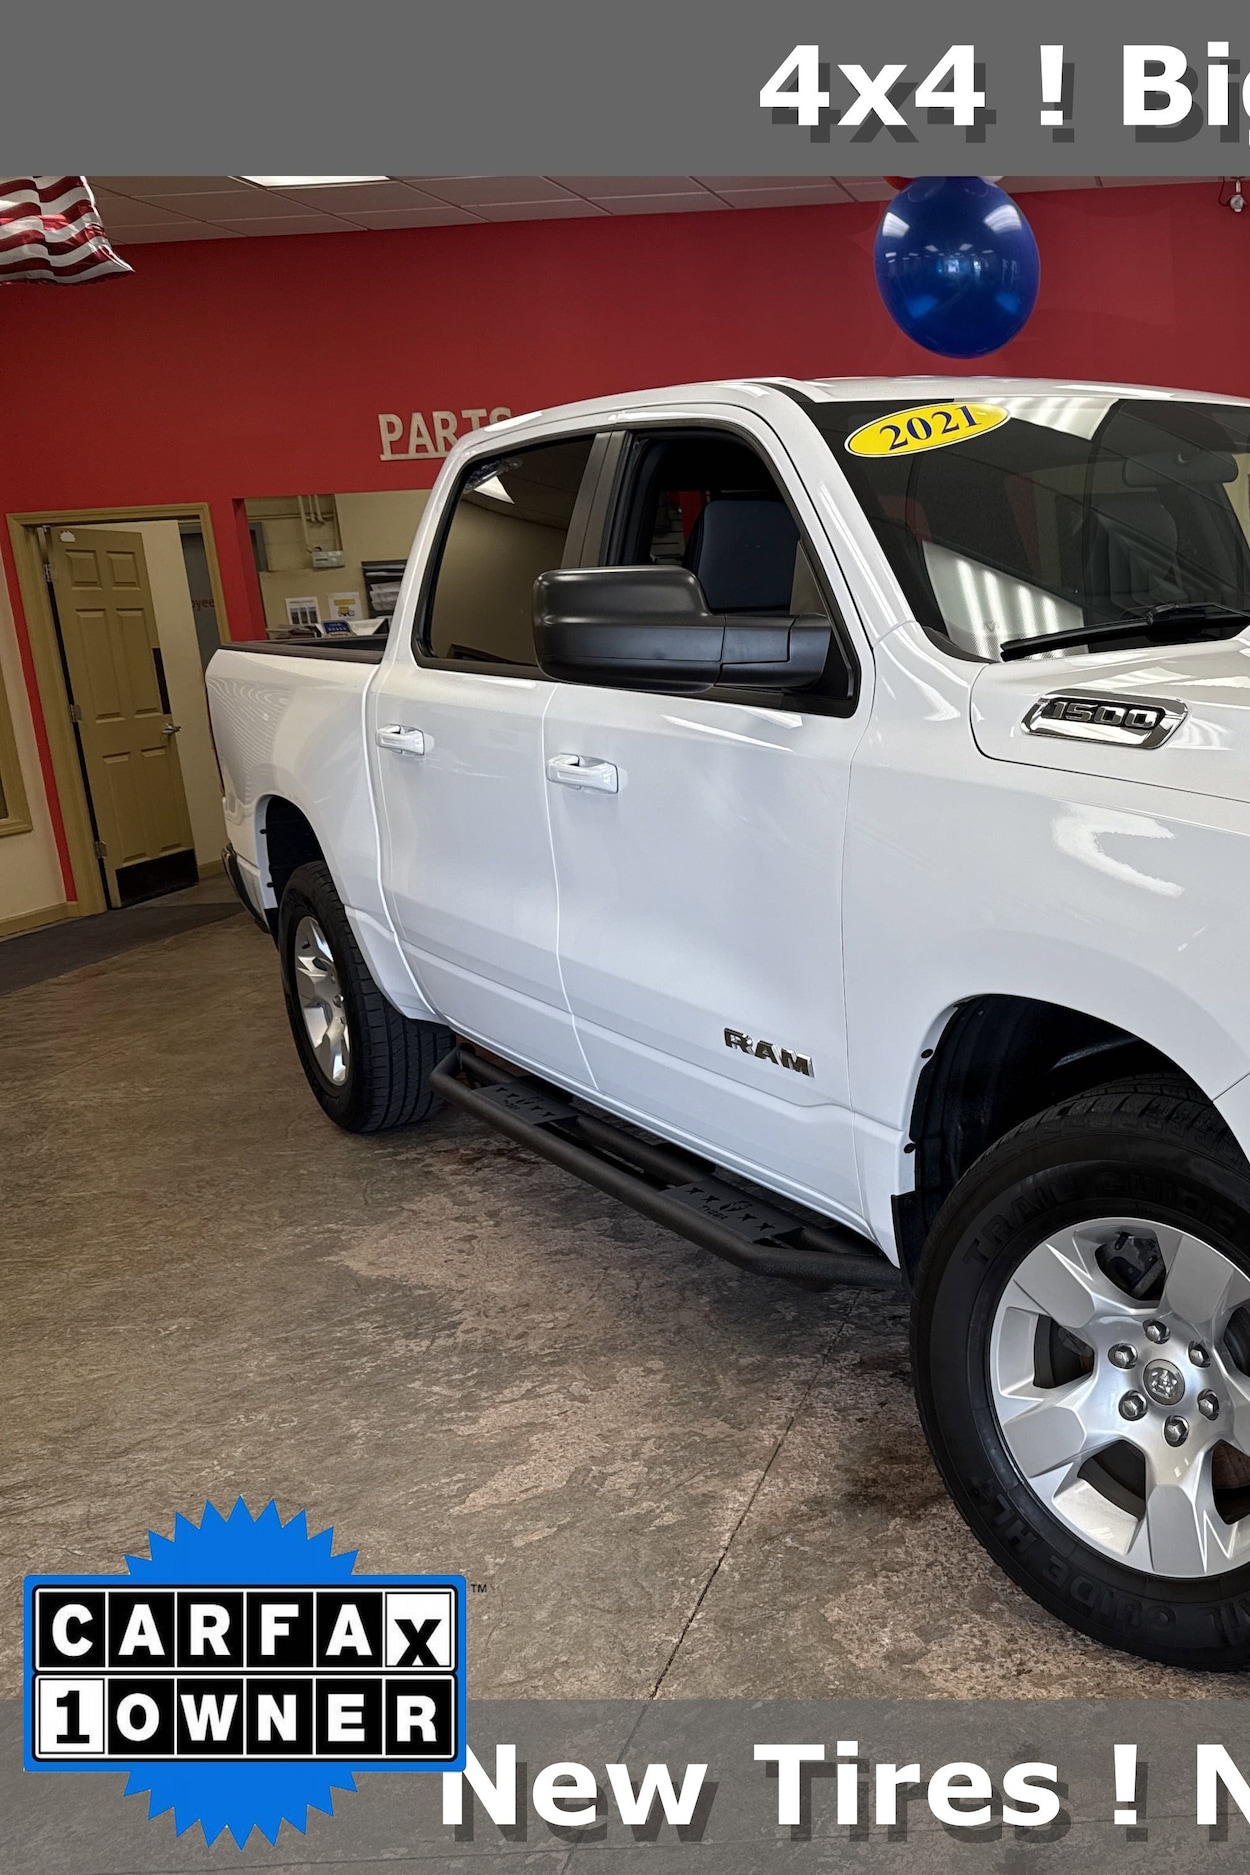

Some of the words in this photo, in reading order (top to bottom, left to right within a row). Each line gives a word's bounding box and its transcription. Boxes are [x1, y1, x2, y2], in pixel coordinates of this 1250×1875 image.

[879, 405, 982, 451] 2021
[1052, 701, 1160, 728] 1500
[724, 1027, 815, 1078] RAM
[962, 1176, 1077, 1266] TRAIL
[1041, 1556, 1177, 1632] GUIDE
